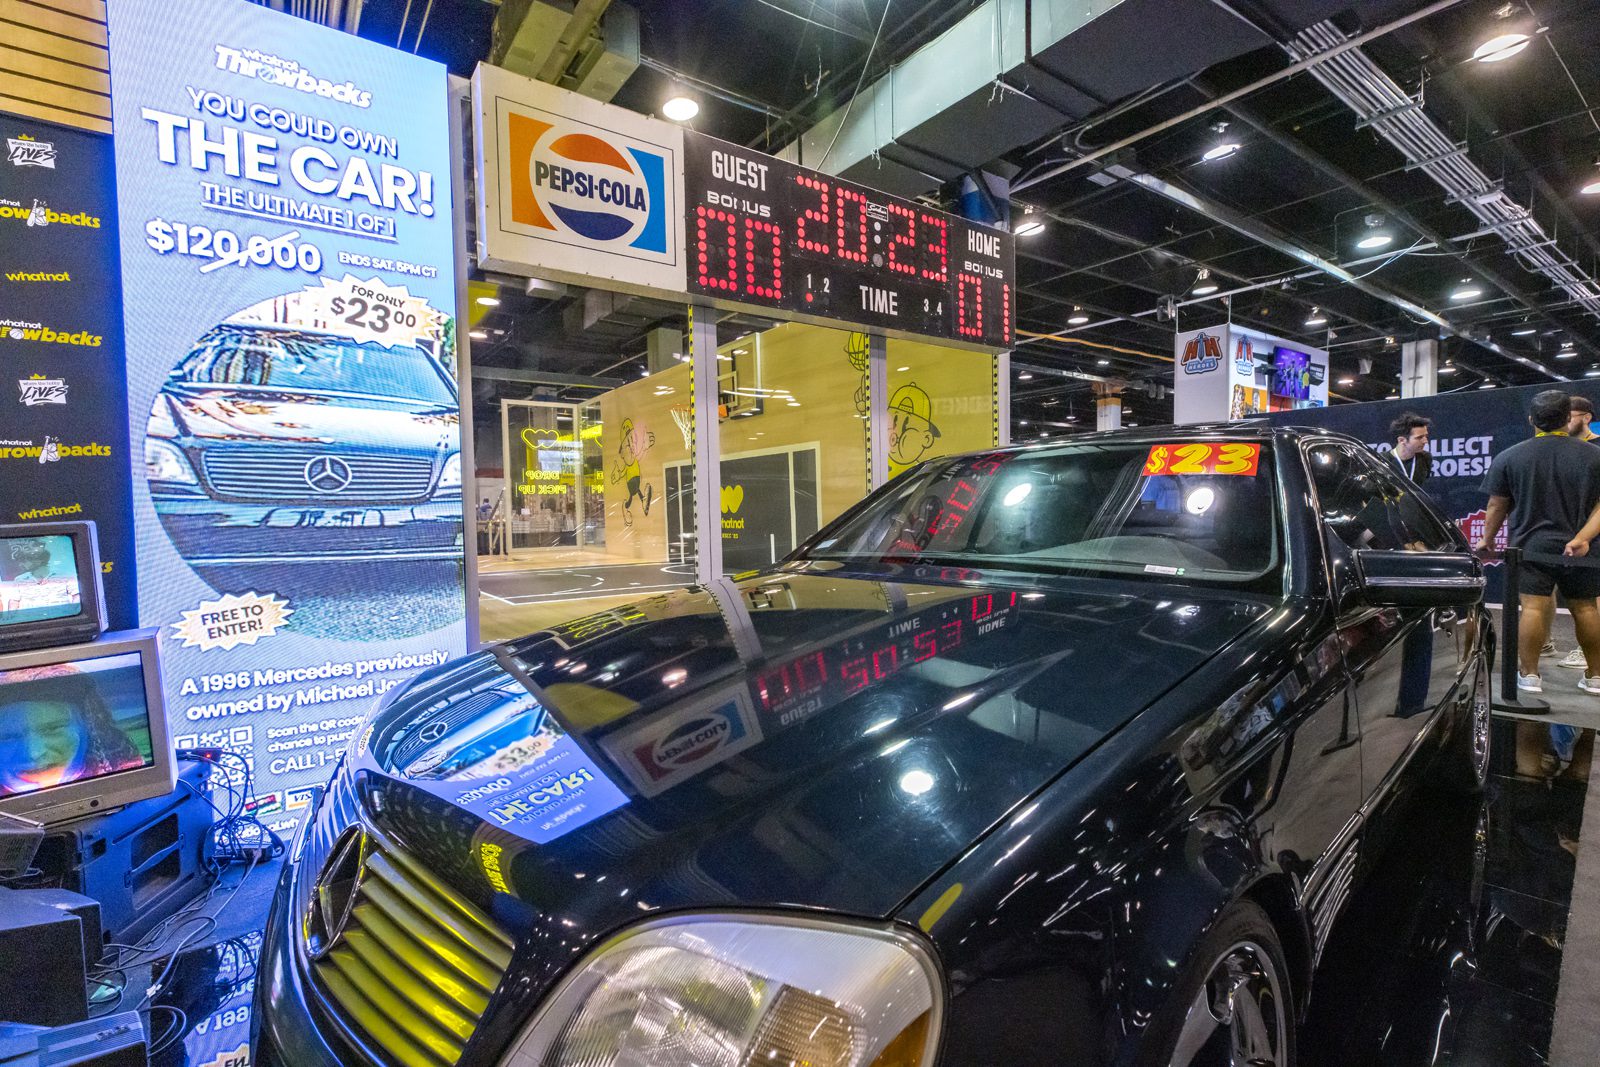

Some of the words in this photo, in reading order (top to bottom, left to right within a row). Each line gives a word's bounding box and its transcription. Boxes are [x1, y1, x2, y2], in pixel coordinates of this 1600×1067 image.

[186, 86, 246, 121] YOU
[250, 103, 337, 143] COULD
[339, 126, 398, 159] OWN
[9, 146, 56, 161] LIVES
[141, 107, 281, 185] THE
[290, 146, 436, 217] CAR!
[711, 150, 769, 191] GUEST
[535, 160, 647, 212] PEPSI-COLA
[200, 181, 245, 207] THE
[247, 189, 343, 228] ULTIMATE
[345, 209, 356, 229] 1
[357, 212, 386, 234] OF
[387, 217, 396, 237] 1
[145, 217, 322, 275] $120,000
[696, 206, 782, 300] 00
[967, 229, 1001, 259] HOME
[5, 271, 71, 282] whatnot
[338, 252, 371, 268] ENDS
[396, 260, 422, 275] 5PM
[422, 264, 438, 278] CT
[806, 273, 812, 289] 1
[823, 277, 830, 293] 2
[351, 284, 375, 299] FOR
[376, 293, 406, 308] ONLY
[859, 285, 898, 316] TIME
[923, 298, 929, 313] 3
[936, 302, 943, 315] 4
[20, 386, 67, 401] LIVES
[1423, 436, 1493, 457] LLECT
[1146, 442, 1256, 475] $23
[1430, 456, 1492, 477] ROES!
[18, 503, 82, 520] whatnot
[721, 517, 745, 529] hatnot
[201, 607, 239, 626] FREE
[242, 604, 264, 617] TO
[207, 618, 264, 640] ENTER!
[180, 678, 199, 696] A
[200, 671, 251, 692] 1996
[254, 660, 354, 686] Mercedes
[356, 650, 449, 678] previously
[186, 695, 264, 721] owned
[266, 691, 295, 713] by
[297, 679, 374, 703] Michael
[267, 726, 299, 739] Scan
[299, 722, 319, 734] the
[320, 719, 337, 731] QR
[267, 738, 313, 752] chance
[314, 735, 326, 745] to
[269, 753, 316, 775] CALL
